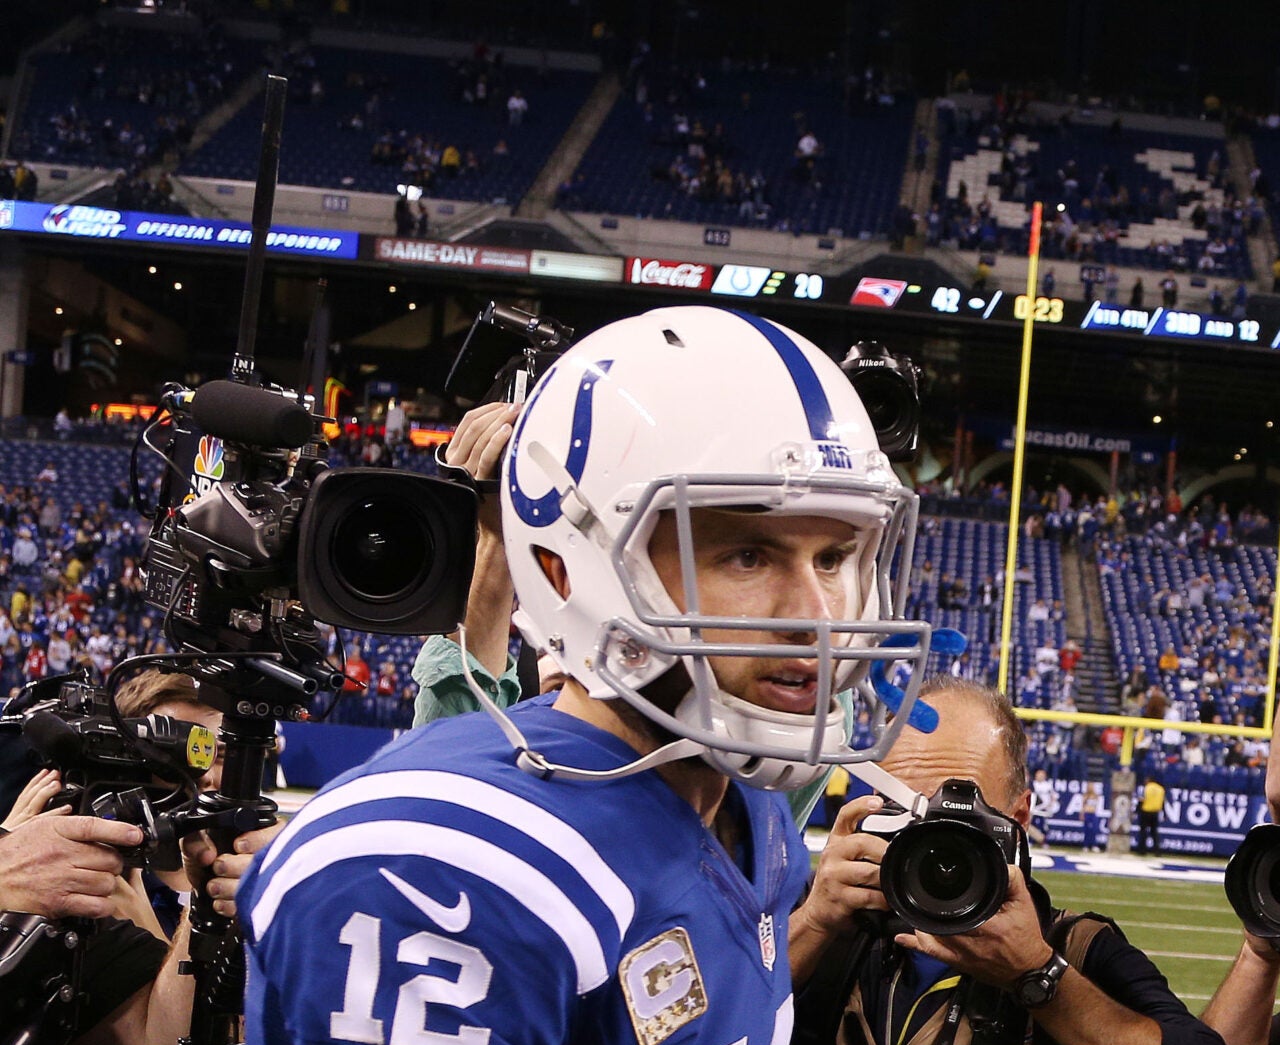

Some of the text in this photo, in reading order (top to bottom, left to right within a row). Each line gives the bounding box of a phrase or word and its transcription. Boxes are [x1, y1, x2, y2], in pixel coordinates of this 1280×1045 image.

[136, 221, 213, 241] OFFICIAL
[265, 232, 342, 252] SPONSOR
[1239, 320, 1260, 341] 12
[858, 359, 885, 368] Nikon
[942, 800, 973, 811] Canon
[1170, 787, 1249, 807] TICKETS
[1162, 801, 1247, 830] NOW
[626, 939, 693, 1019] C
